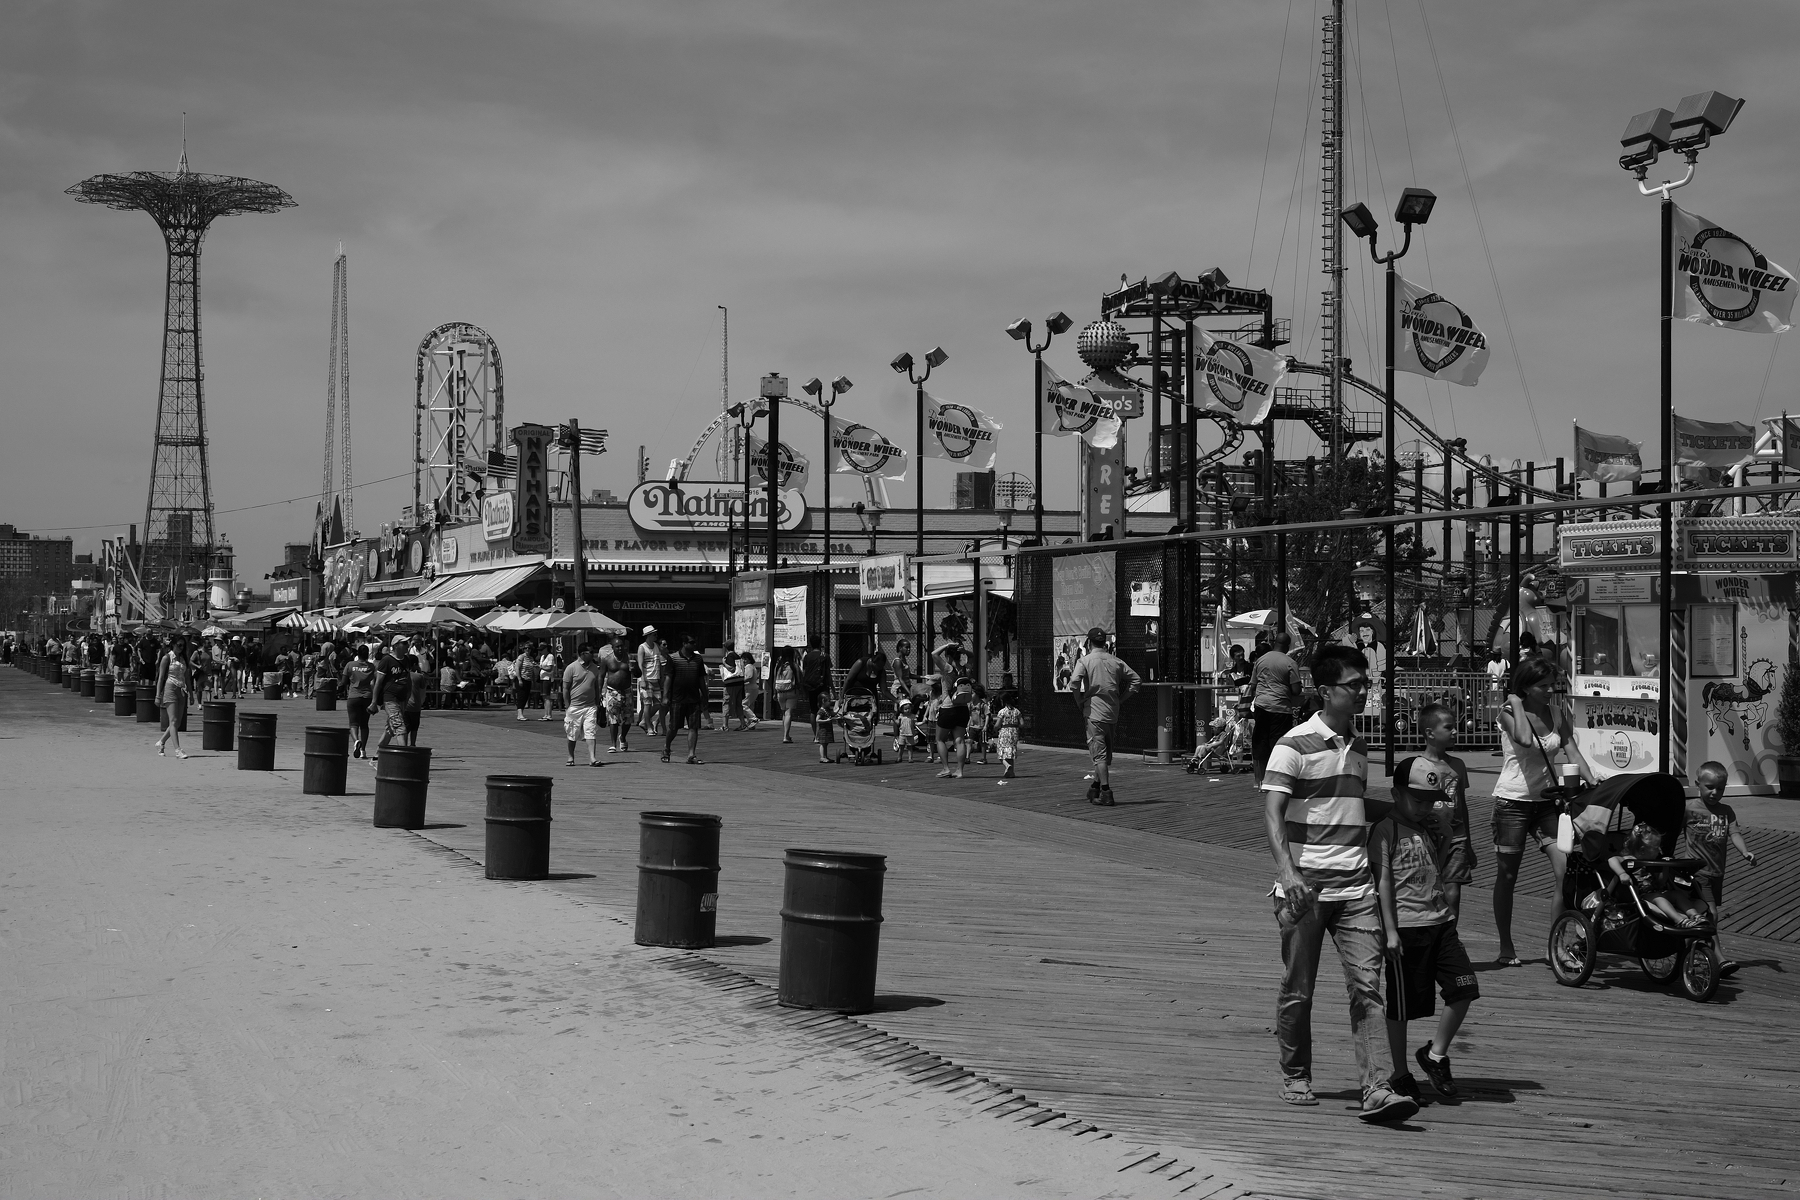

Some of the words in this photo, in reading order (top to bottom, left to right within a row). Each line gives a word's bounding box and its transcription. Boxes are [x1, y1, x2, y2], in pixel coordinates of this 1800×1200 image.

[1697, 231, 1711, 243] SINCE
[1679, 236, 1711, 258] Deno's
[1678, 253, 1735, 281] WONDER
[1738, 267, 1790, 292] WHEEL
[1702, 277, 1736, 290] AMUSEMENT
[1737, 284, 1750, 293] PARK
[1713, 310, 1726, 319] OVER
[1727, 311, 1734, 319] 35
[1401, 314, 1445, 338] WONDER
[1446, 325, 1486, 350] WHEEL
[1195, 357, 1236, 382] WONDER
[1079, 401, 1115, 420] WHEEL
[518, 429, 550, 437] ORIGINAL
[929, 419, 962, 435] WONDER
[962, 426, 993, 441] WHEEL
[833, 438, 871, 452] WONDER
[873, 444, 902, 457] WHEEL
[1680, 432, 1752, 450] TICKETS
[780, 460, 804, 474] WHEEL
[525, 436, 542, 535] NATHANS
[642, 485, 792, 524] Nathans
[582, 540, 609, 551] THE
[614, 540, 668, 551] FLAVOR
[673, 540, 691, 552] OF
[697, 540, 728, 552] NEW
[752, 545, 761, 554] W
[1571, 536, 1655, 558] TICKETS
[1692, 535, 1789, 554] TICKETS
[114, 536, 124, 625] THUNDERBOLT
[1715, 576, 1750, 590] WONDER
[1723, 587, 1750, 599] WHEEL
[1585, 702, 1658, 727] TICKETS
